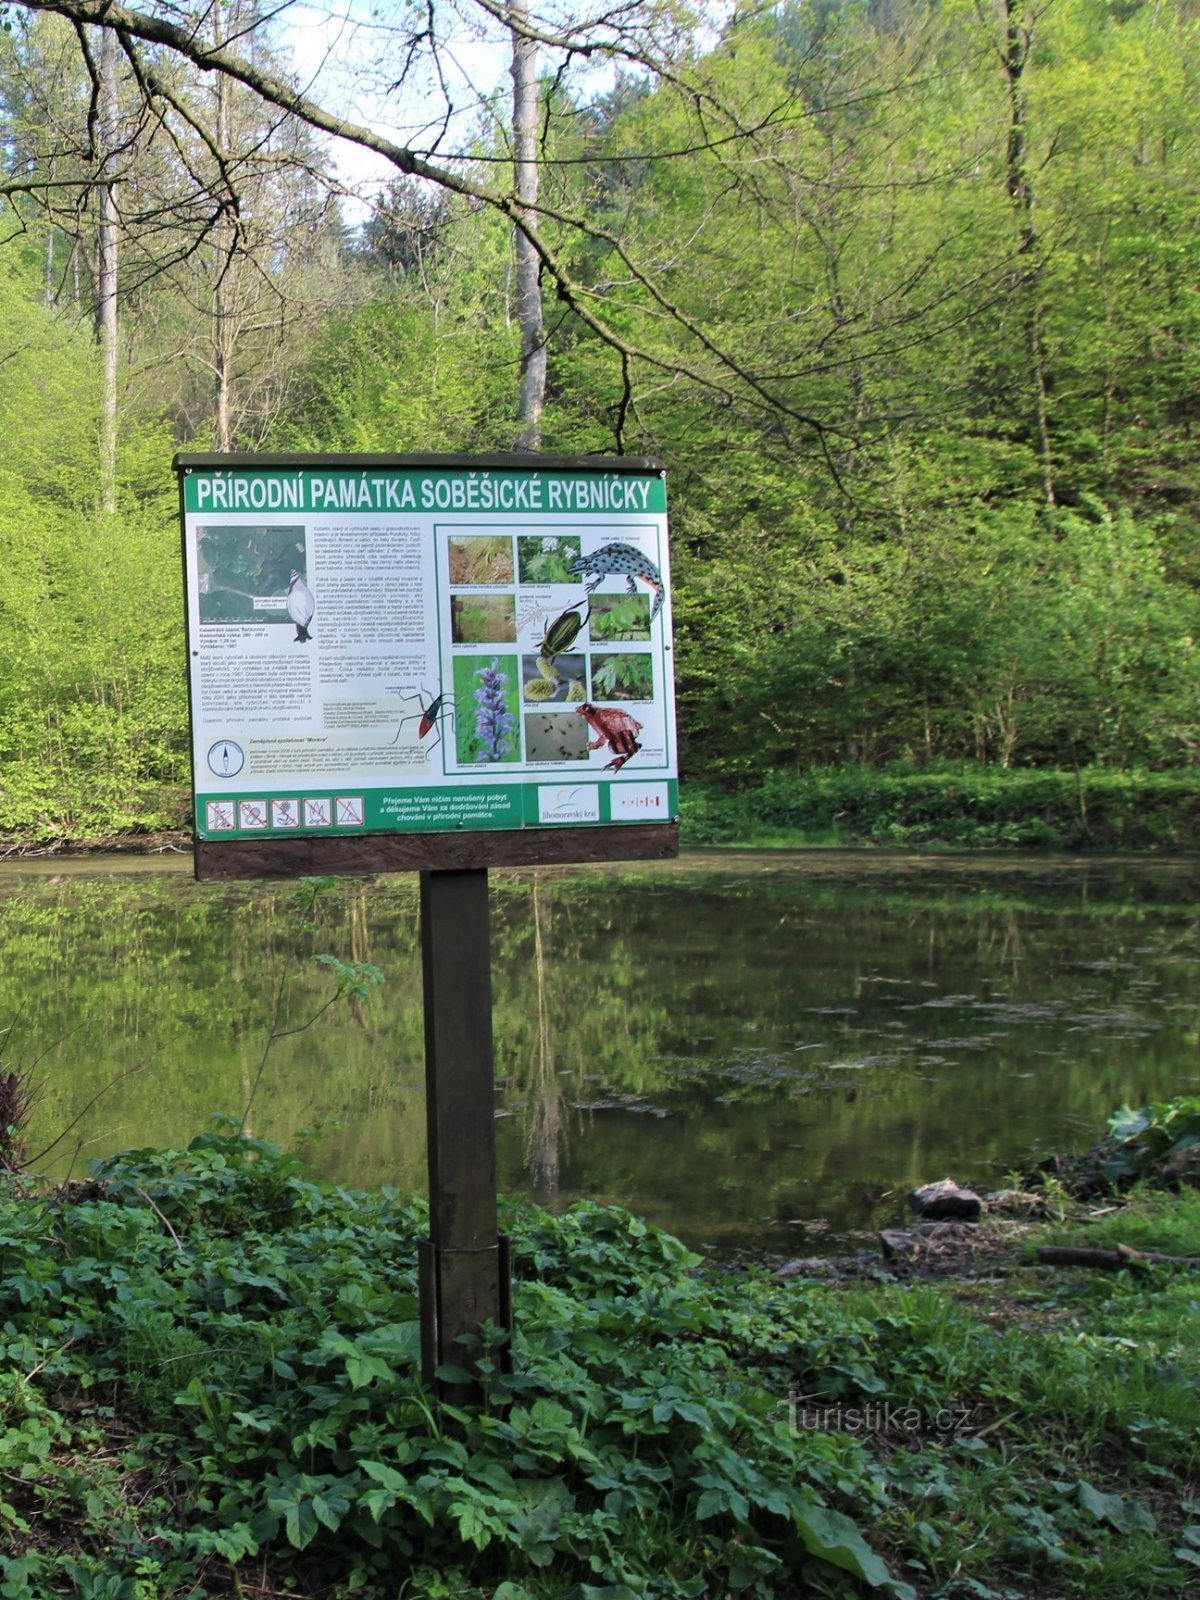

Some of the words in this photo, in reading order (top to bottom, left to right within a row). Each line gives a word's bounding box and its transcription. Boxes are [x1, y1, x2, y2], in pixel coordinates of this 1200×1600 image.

[197, 471, 305, 508] PŘÍRODNÍ
[310, 471, 417, 508] PAMÁTKA
[420, 472, 543, 509] SOBĚŠICKÉ
[548, 474, 651, 509] RYBNÍČKY
[383, 796, 412, 805] Přejeme
[452, 794, 485, 804] nerušený
[486, 793, 508, 803] pobyt
[386, 805, 421, 815] děkujeme
[396, 813, 426, 821] chování
[433, 812, 461, 822] přírodní
